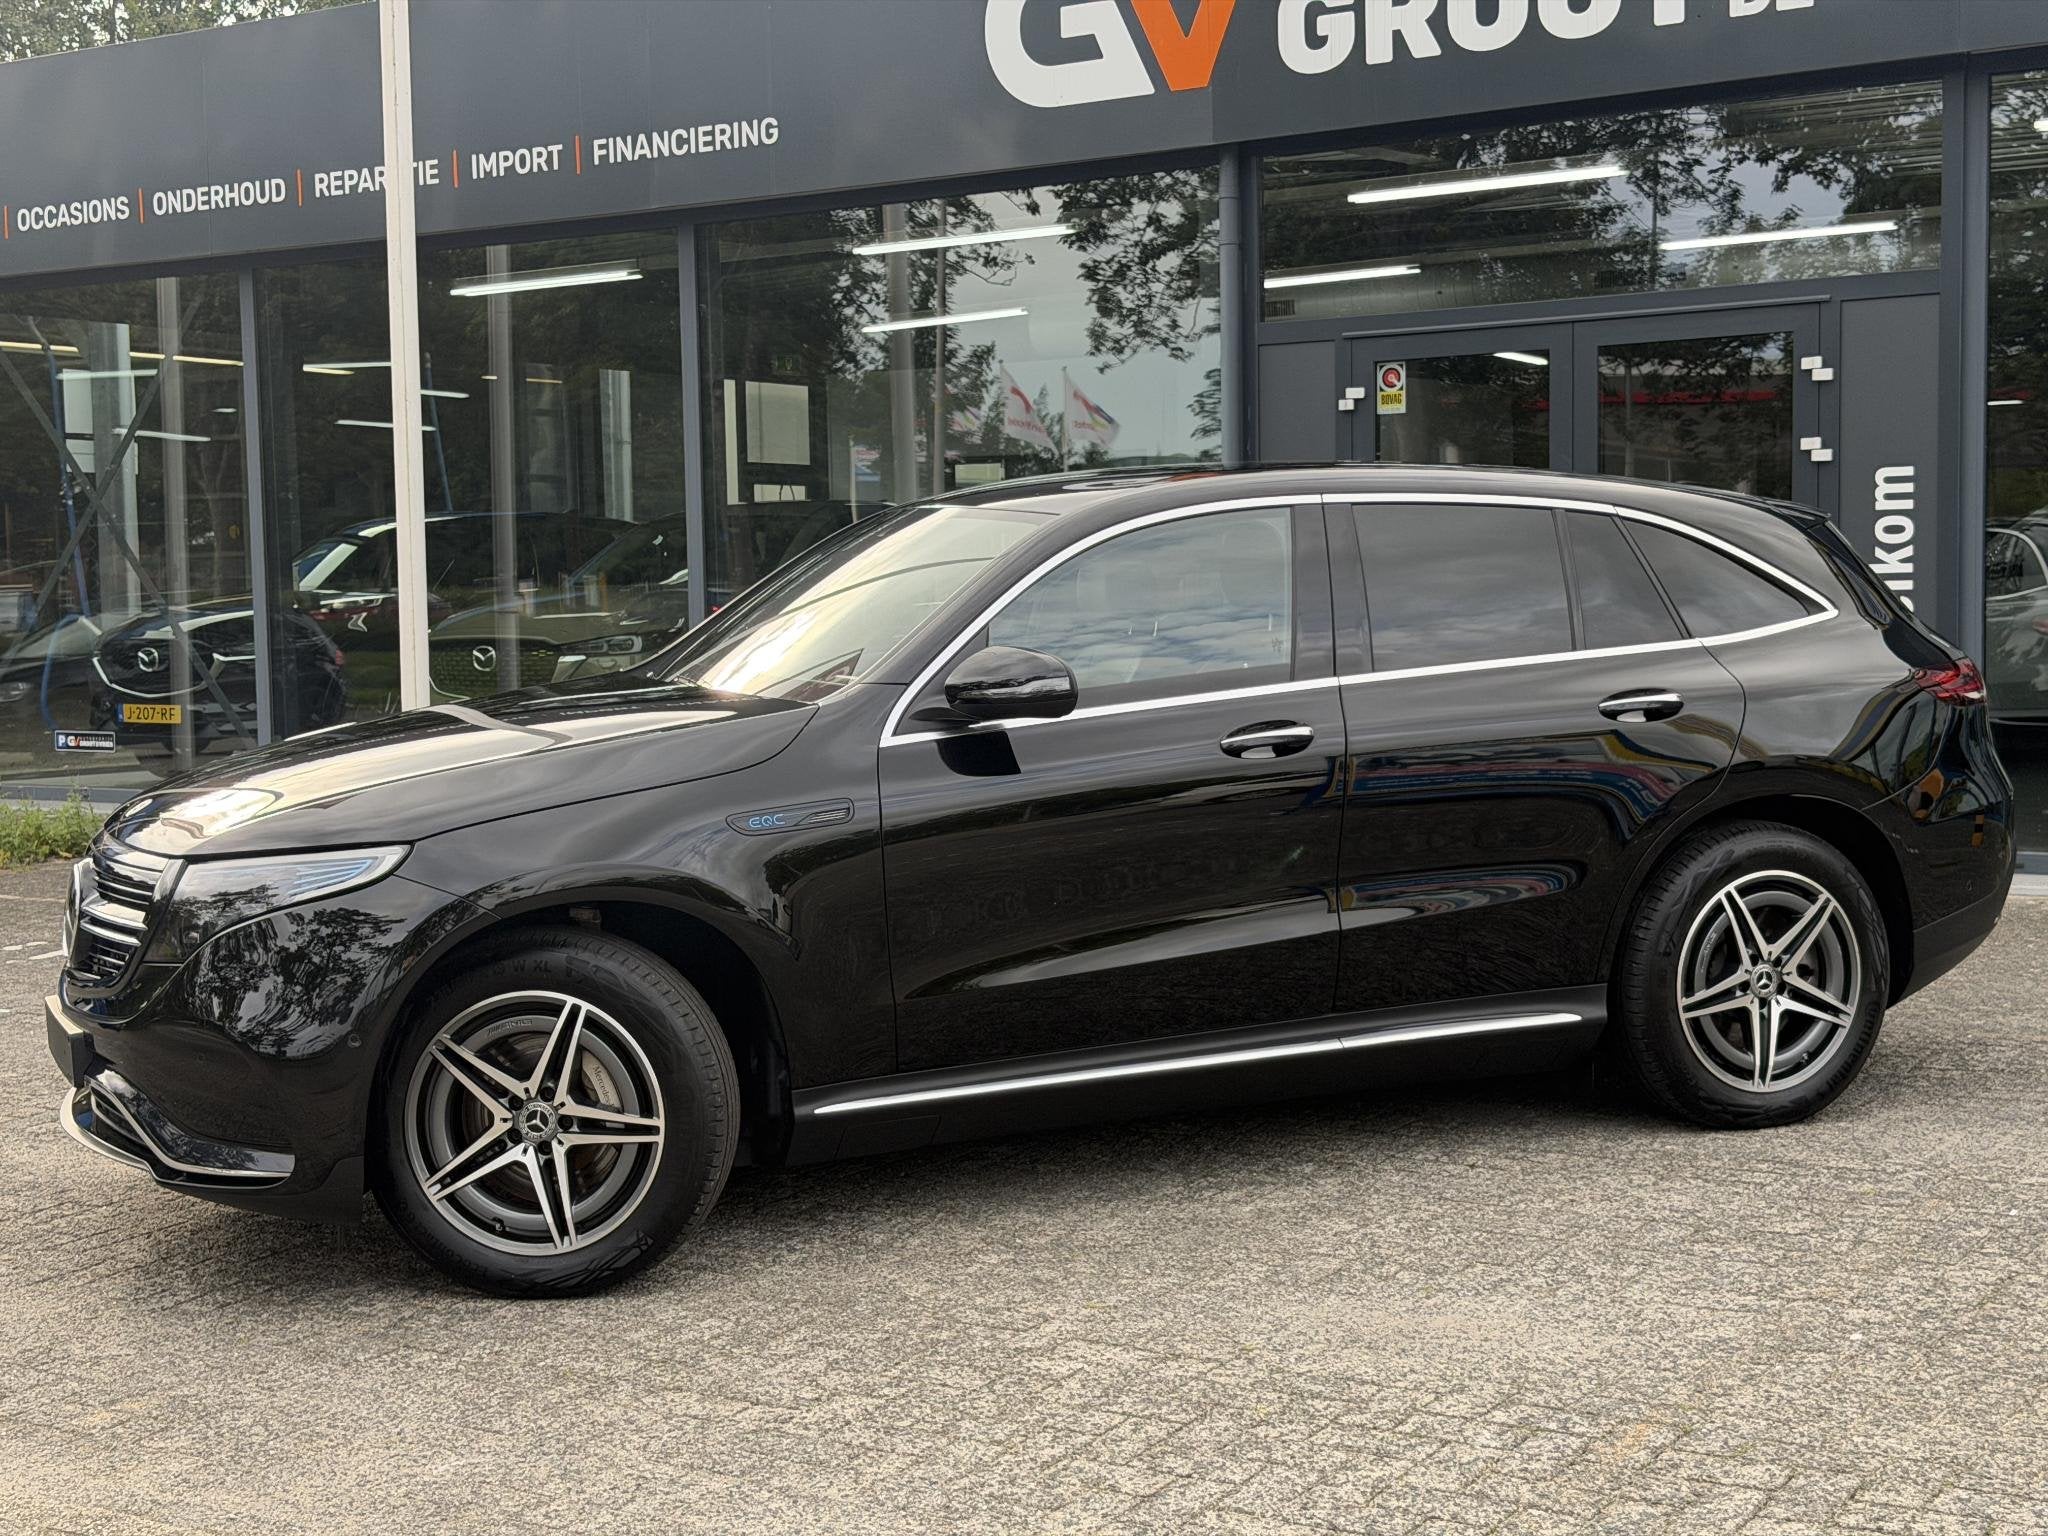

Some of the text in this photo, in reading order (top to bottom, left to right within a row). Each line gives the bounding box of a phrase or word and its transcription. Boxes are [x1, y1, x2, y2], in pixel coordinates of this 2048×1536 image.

[17, 117, 779, 232] OCCASIONS ONDERHOUD REPARIE IMPORT FINANCIERING
[127, 706, 176, 721] J-207-RF
[749, 813, 786, 829] EQC
